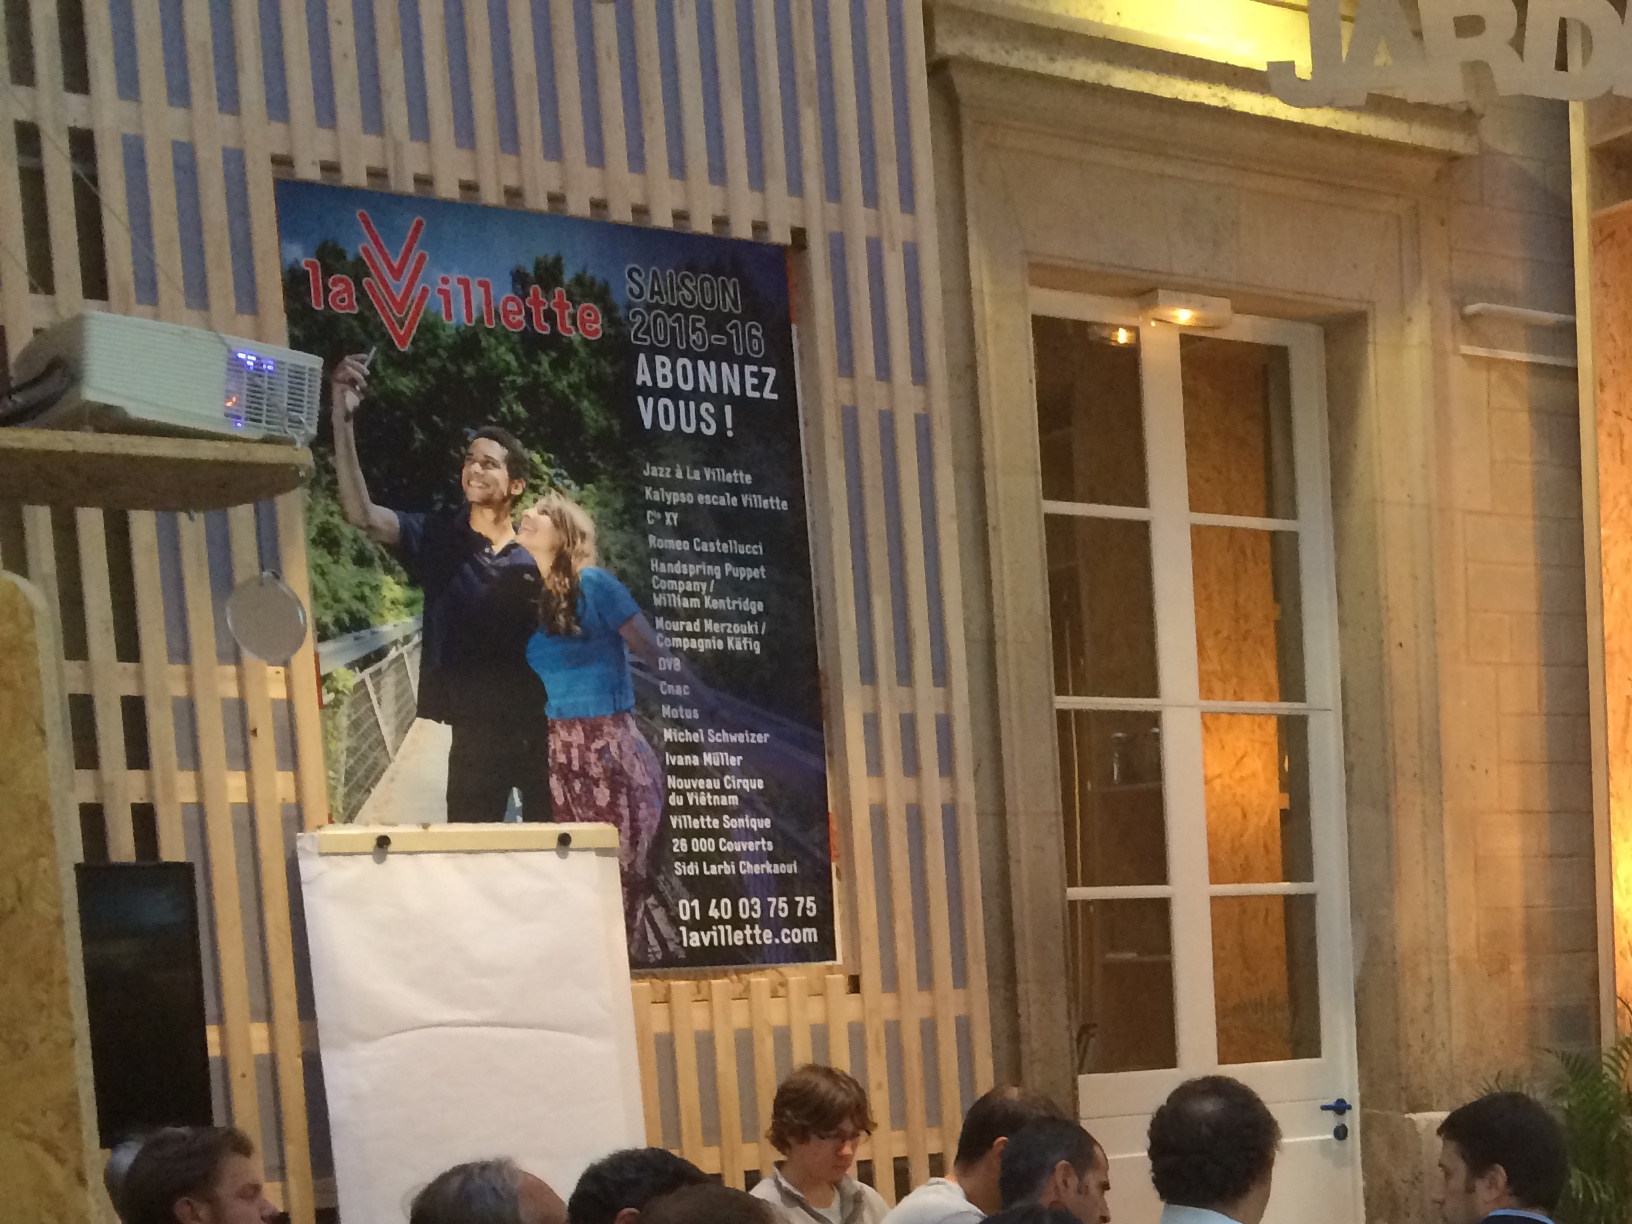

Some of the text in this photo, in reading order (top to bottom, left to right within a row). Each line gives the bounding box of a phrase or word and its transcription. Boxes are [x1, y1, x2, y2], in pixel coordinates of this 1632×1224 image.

[625, 264, 742, 314] SAISON
[629, 309, 765, 358] 2015-16
[636, 352, 779, 400] ABONNEZ
[643, 463, 752, 485] Jazz à La Villette
[645, 487, 788, 511] Kalypso escale Villette
[648, 534, 763, 555] Romeo Castellucci
[650, 558, 766, 580] Handspring Puppet
[653, 593, 764, 615] William Kentridge
[655, 616, 700, 632] Mourad
[656, 634, 724, 652] Compagnie
[658, 657, 681, 671] DV8
[660, 681, 690, 696] Cnac
[661, 704, 699, 720] Motus
[663, 728, 770, 744] Michel Schweizer
[665, 751, 743, 767] Ivana Müller
[667, 775, 764, 792] Nouveau Cirque
[669, 791, 739, 806] du Viêtnam
[669, 815, 771, 831] Villette Sonique
[672, 838, 773, 853] 26 000 Couverts
[674, 860, 797, 876] Sidi Larbi Cherkaoui
[678, 896, 817, 921] 01 40 03 75 75
[679, 925, 818, 948] lavillette.com
